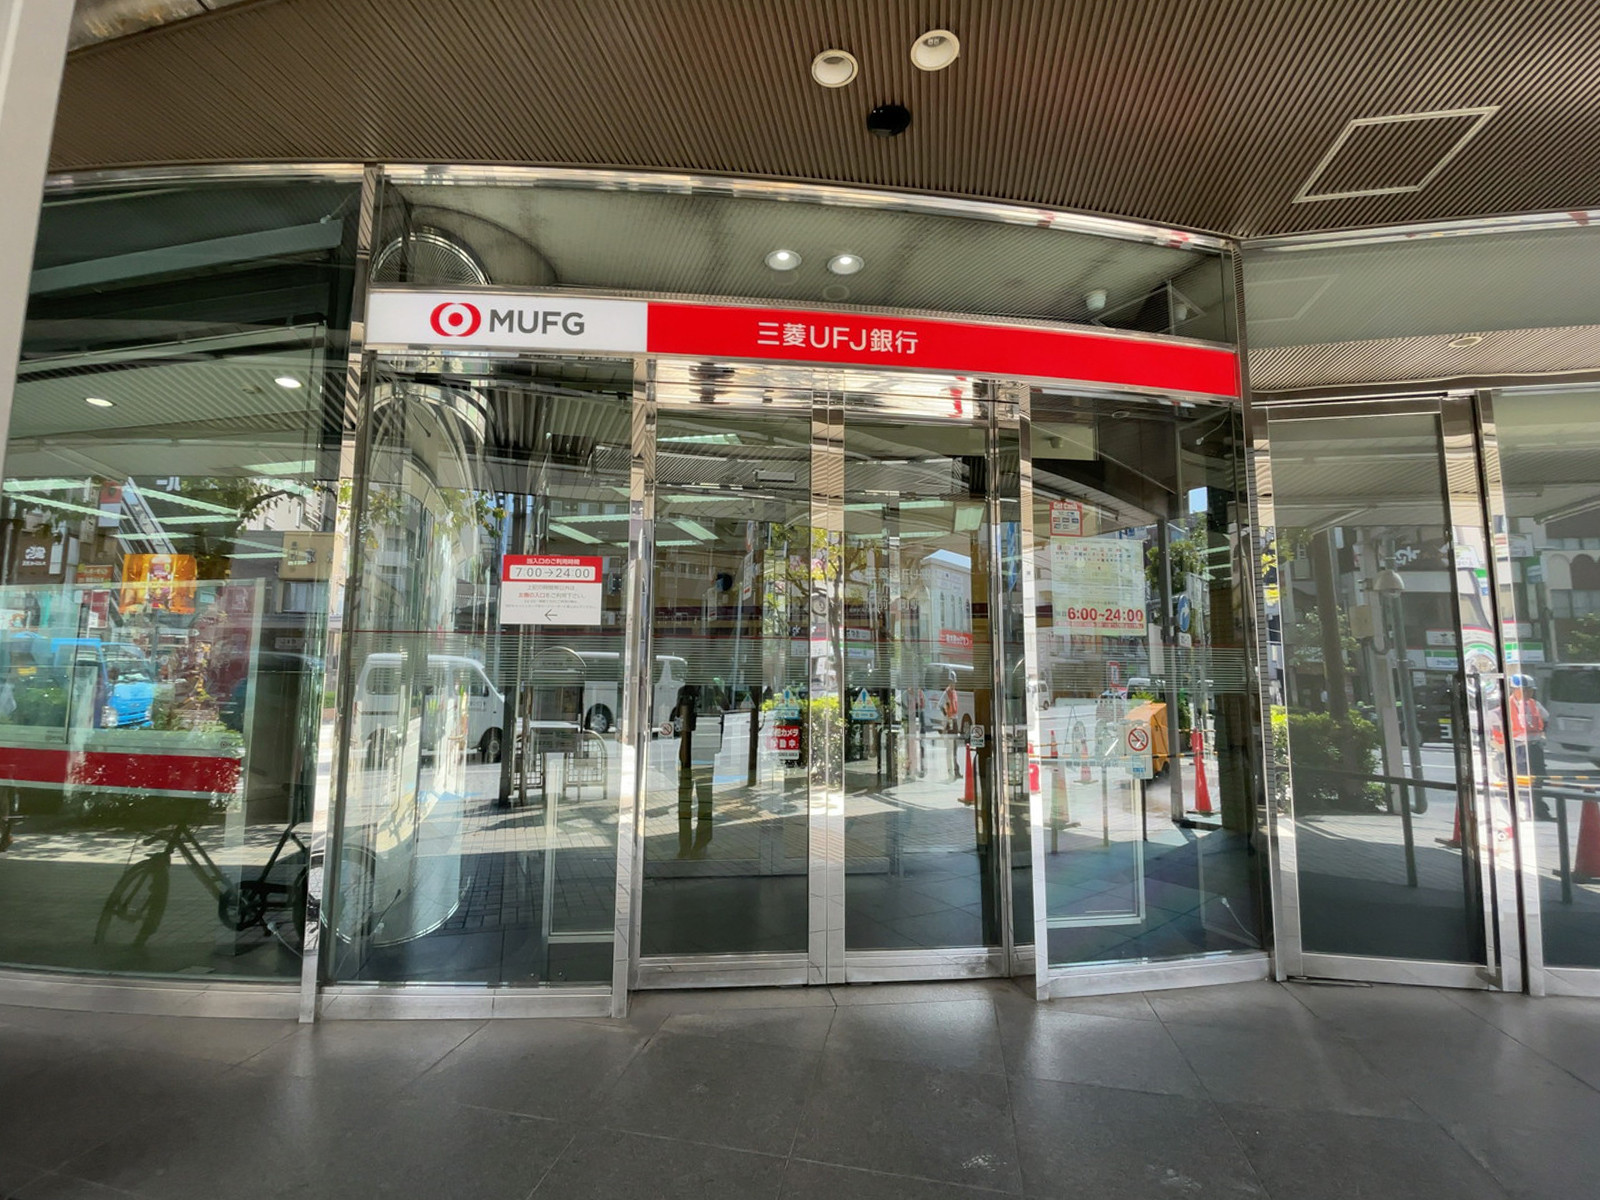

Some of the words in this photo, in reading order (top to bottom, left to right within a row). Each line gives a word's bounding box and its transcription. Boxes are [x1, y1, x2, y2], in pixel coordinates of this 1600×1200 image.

[489, 309, 585, 336] MUFG
[757, 321, 919, 354] 三菱UFJ銀行
